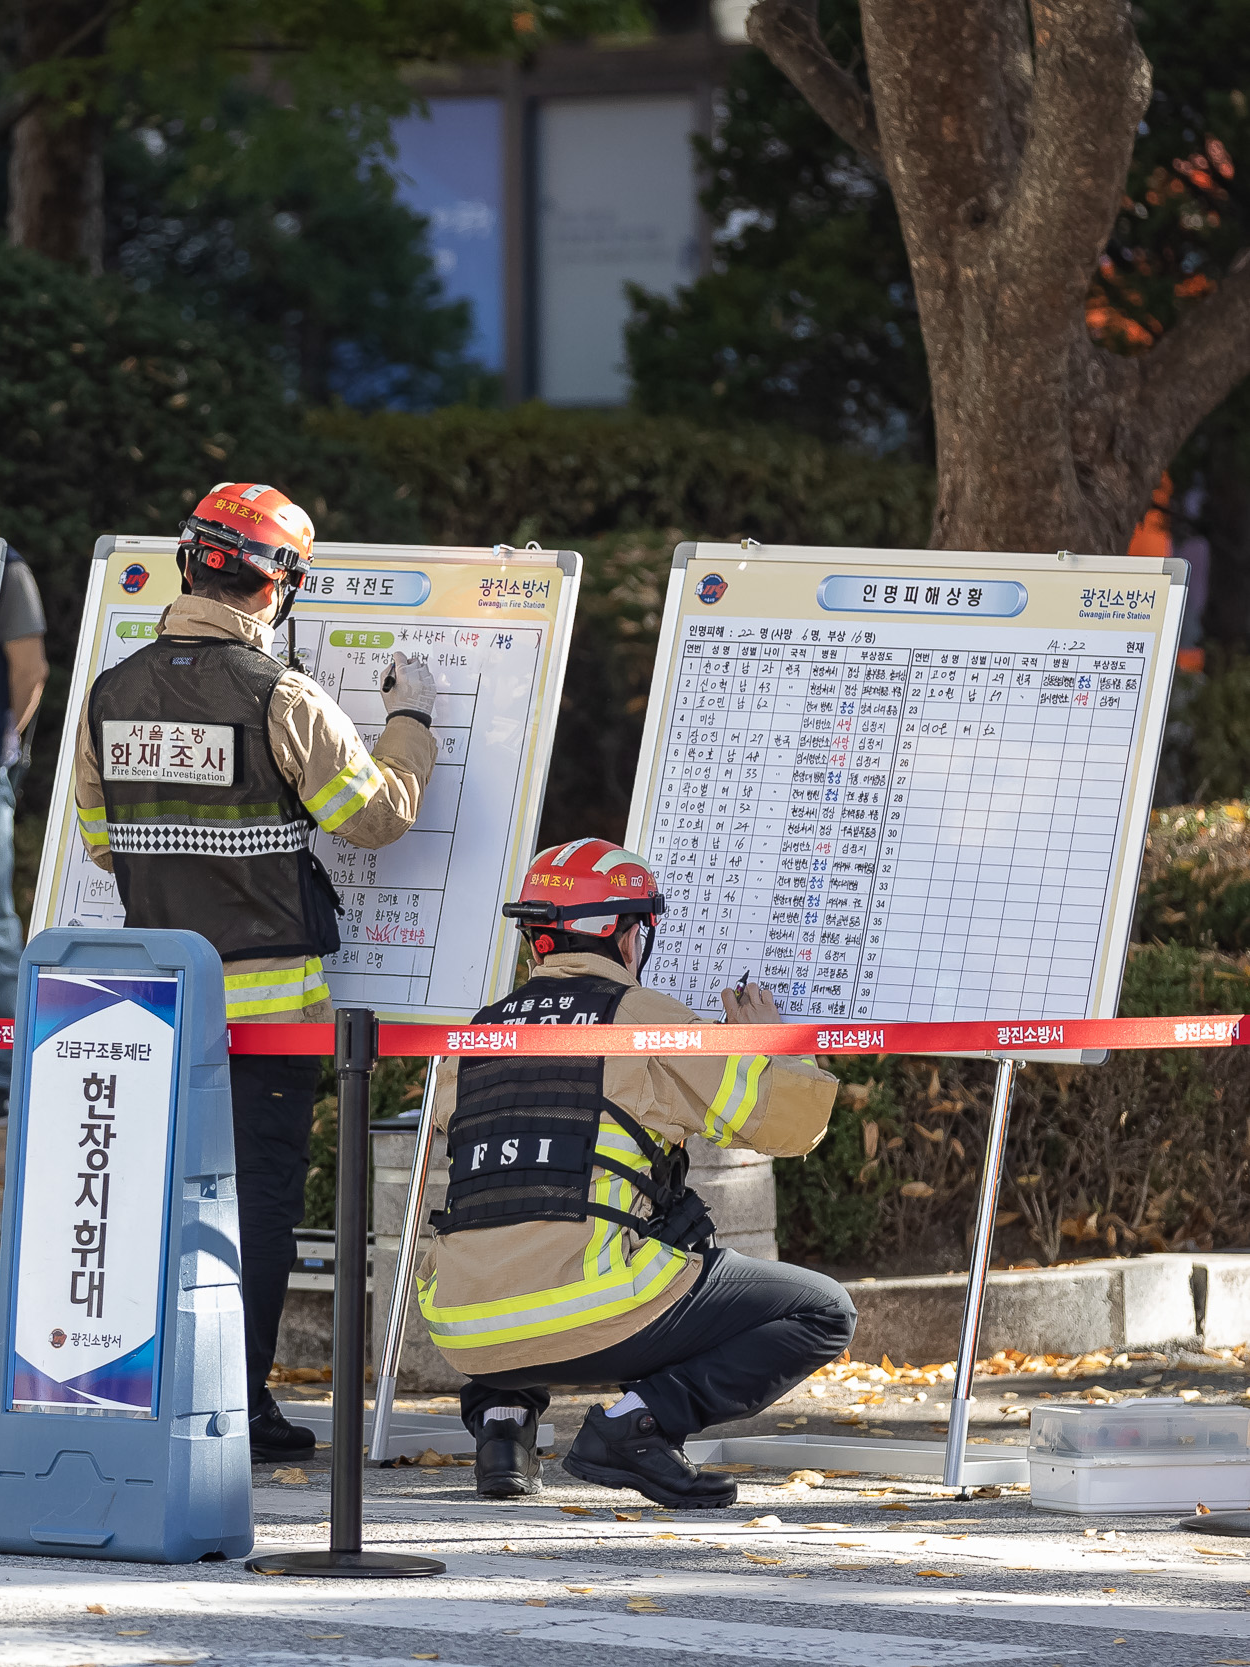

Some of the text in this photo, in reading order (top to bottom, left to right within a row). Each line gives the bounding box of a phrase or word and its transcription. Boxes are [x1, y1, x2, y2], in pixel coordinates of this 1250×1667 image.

[214, 498, 264, 524] 화재조사
[346, 577, 394, 596] 작전도
[479, 578, 550, 598] 광진소방서
[863, 584, 982, 607] 인명피해상황
[1080, 589, 1156, 610] 광진소방서
[478, 598, 546, 610] Gwangjin Fire Station
[1078, 609, 1151, 621] Gwangjin Fire Station
[343, 633, 382, 646] 평면도
[412, 630, 446, 643] 사상자
[688, 625, 846, 642] 인명피해 부상
[686, 644, 702, 654] 연번
[740, 645, 758, 657] 성별
[763, 647, 781, 658] 나이
[789, 647, 808, 659] 국적
[820, 648, 839, 660] 병원
[859, 650, 894, 662] 부상정도
[1126, 641, 1144, 653] 현재
[438, 654, 467, 666] 위치도
[914, 652, 931, 664] 연번
[970, 654, 988, 666] 성별
[993, 655, 1012, 666] 나이
[1020, 656, 1039, 667] 국적
[1052, 657, 1070, 669] 병원
[1092, 658, 1127, 671] 부상정도
[319, 670, 336, 686] 옥상
[914, 670, 924, 680] 21
[685, 679, 692, 688] 2
[682, 696, 689, 705] 3
[911, 688, 922, 698] 22
[678, 713, 685, 722] 4
[699, 713, 716, 726] 미상
[837, 718, 852, 731] 사망
[905, 723, 915, 733] 24
[129, 724, 206, 745] 서울소방
[675, 730, 849, 749] 5 사망
[902, 740, 912, 750] 25
[110, 742, 226, 772] 화재조사
[673, 748, 846, 767] 6 사망
[111, 765, 226, 782] Fire Scene Investigation
[667, 783, 674, 793] 8
[664, 800, 671, 810] 9
[660, 818, 669, 827] 10
[658, 835, 666, 845] 11
[887, 828, 898, 838] 30
[337, 853, 356, 866] 계단
[654, 852, 664, 862] 12
[530, 873, 575, 890] 화재조사
[610, 874, 643, 887] 서울 119
[375, 909, 400, 922] 화장실
[405, 912, 418, 926] 2명
[342, 950, 383, 968] 로비 2명
[503, 997, 574, 1013] 서울소방
[857, 1005, 868, 1015] 40
[816, 1031, 884, 1047] 광진소방서
[997, 1026, 1064, 1044] 광진소방서
[1174, 1022, 1239, 1041] 광진소방서
[447, 1031, 517, 1049] 광진소방서
[633, 1031, 702, 1049] 광진소방서
[56, 1041, 152, 1060] 긴급구조통제단
[70, 1072, 117, 1318] 현장지휘대
[71, 1333, 122, 1348] 광진소방서
